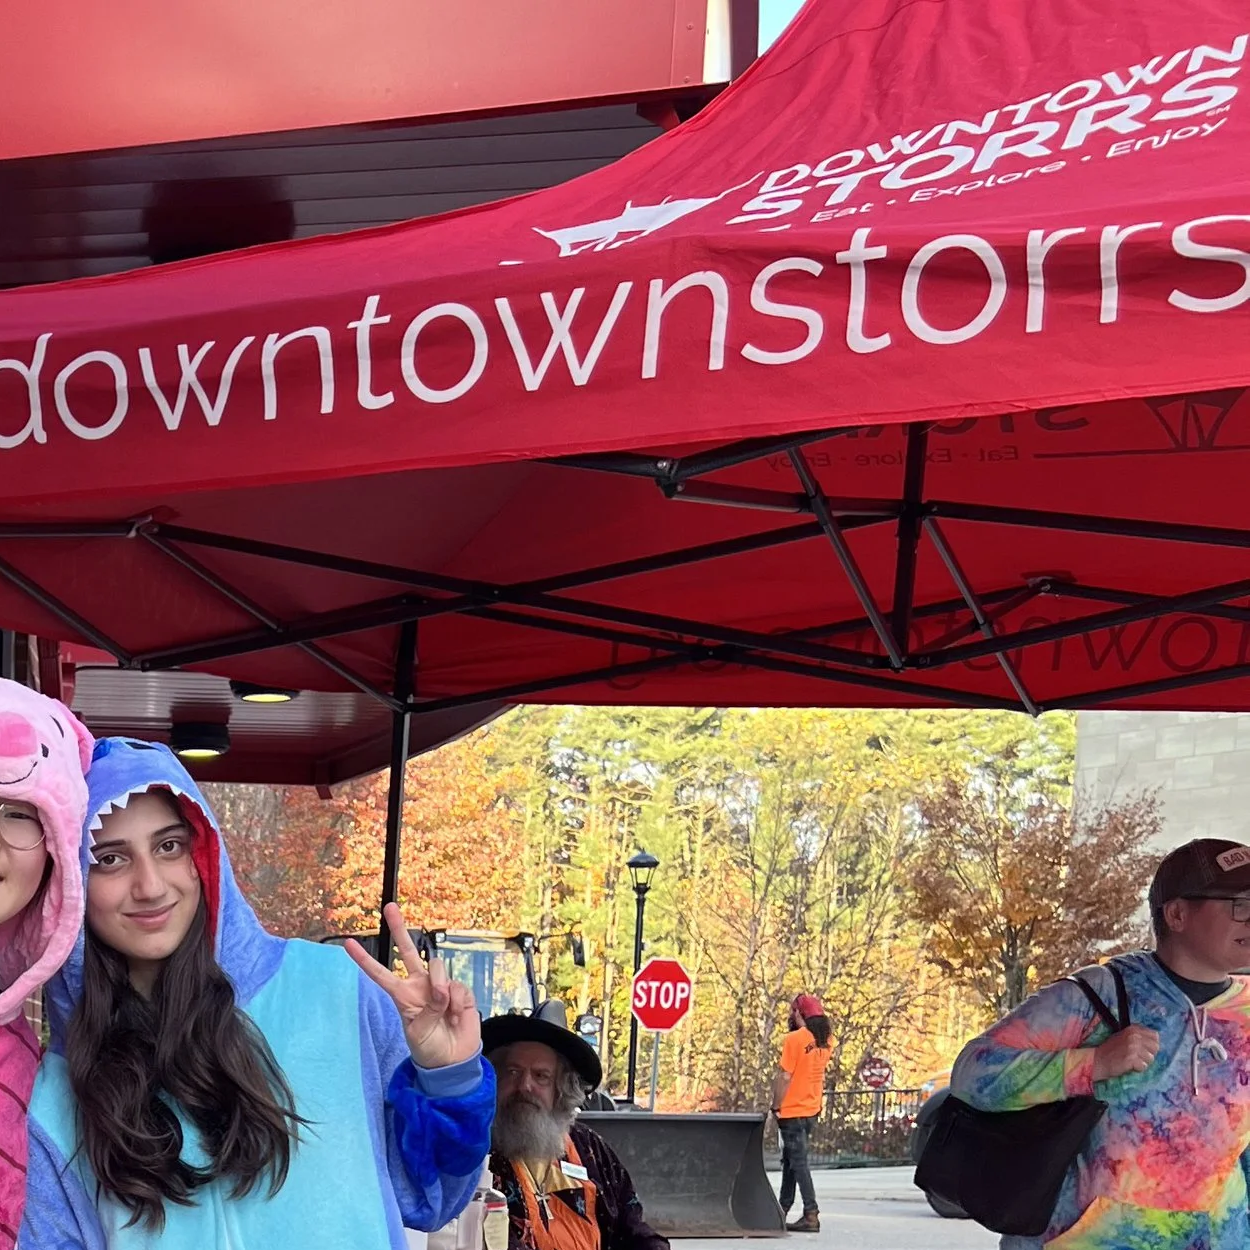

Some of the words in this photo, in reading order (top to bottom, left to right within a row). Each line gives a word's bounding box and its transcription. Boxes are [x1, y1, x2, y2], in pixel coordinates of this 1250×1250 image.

[726, 66, 1242, 225] STORRS
[759, 34, 1249, 194] DOWNTOWN
[810, 202, 872, 222] Eat
[909, 161, 1067, 202] Explore
[1106, 118, 1227, 159] Enjoy
[634, 980, 690, 1010] STOP
